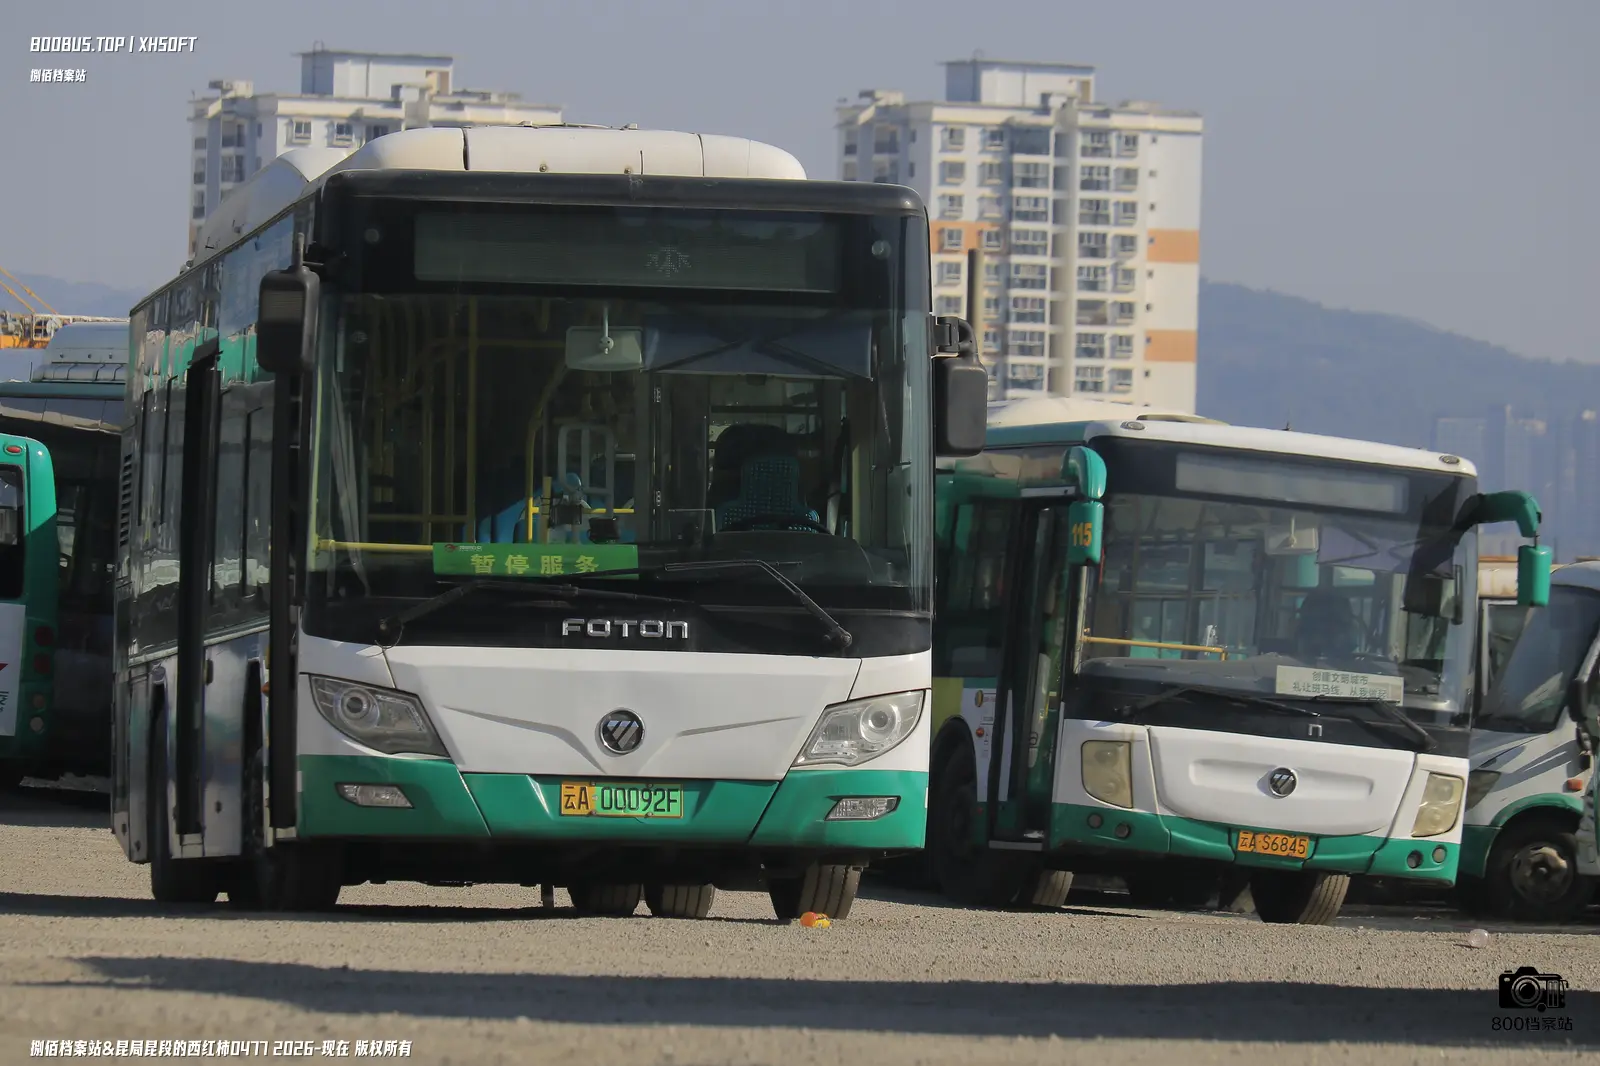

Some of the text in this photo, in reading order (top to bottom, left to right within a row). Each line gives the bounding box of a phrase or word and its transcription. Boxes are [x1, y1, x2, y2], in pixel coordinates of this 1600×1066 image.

[1072, 522, 1093, 546] 115
[470, 554, 600, 575] 暂停服务
